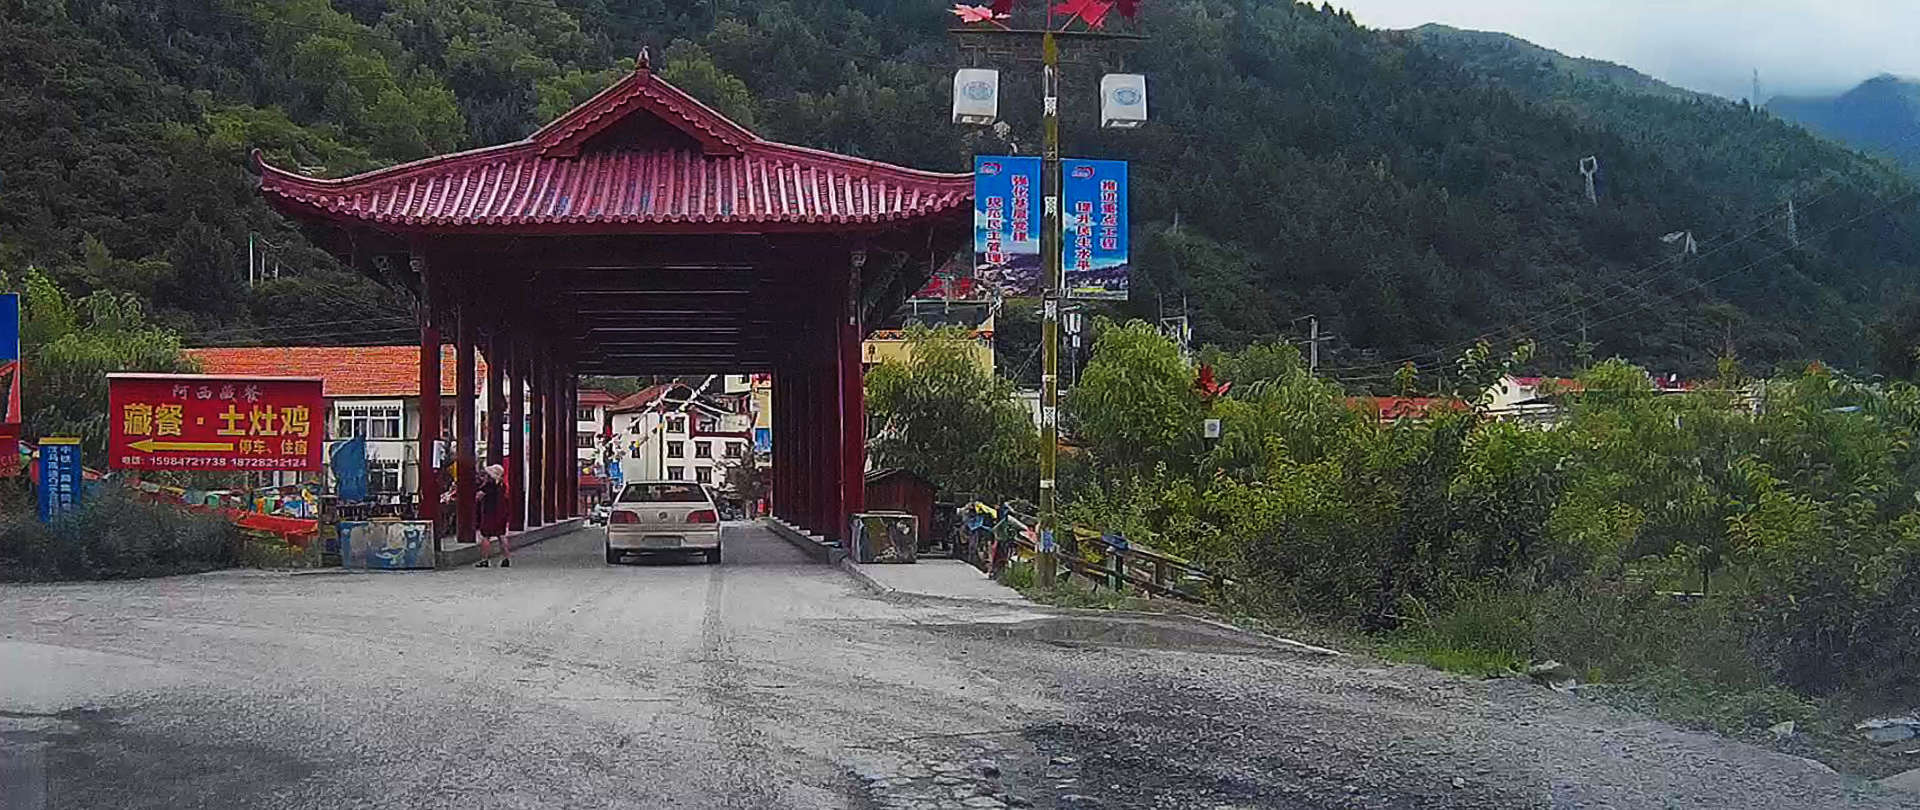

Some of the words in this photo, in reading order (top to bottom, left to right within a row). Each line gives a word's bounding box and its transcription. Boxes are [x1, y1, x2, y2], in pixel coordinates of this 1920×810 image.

[985, 196, 1003, 264] 规范民主管理
[149, 456, 227, 467] 15984721738
[230, 457, 307, 468] 18728212124
